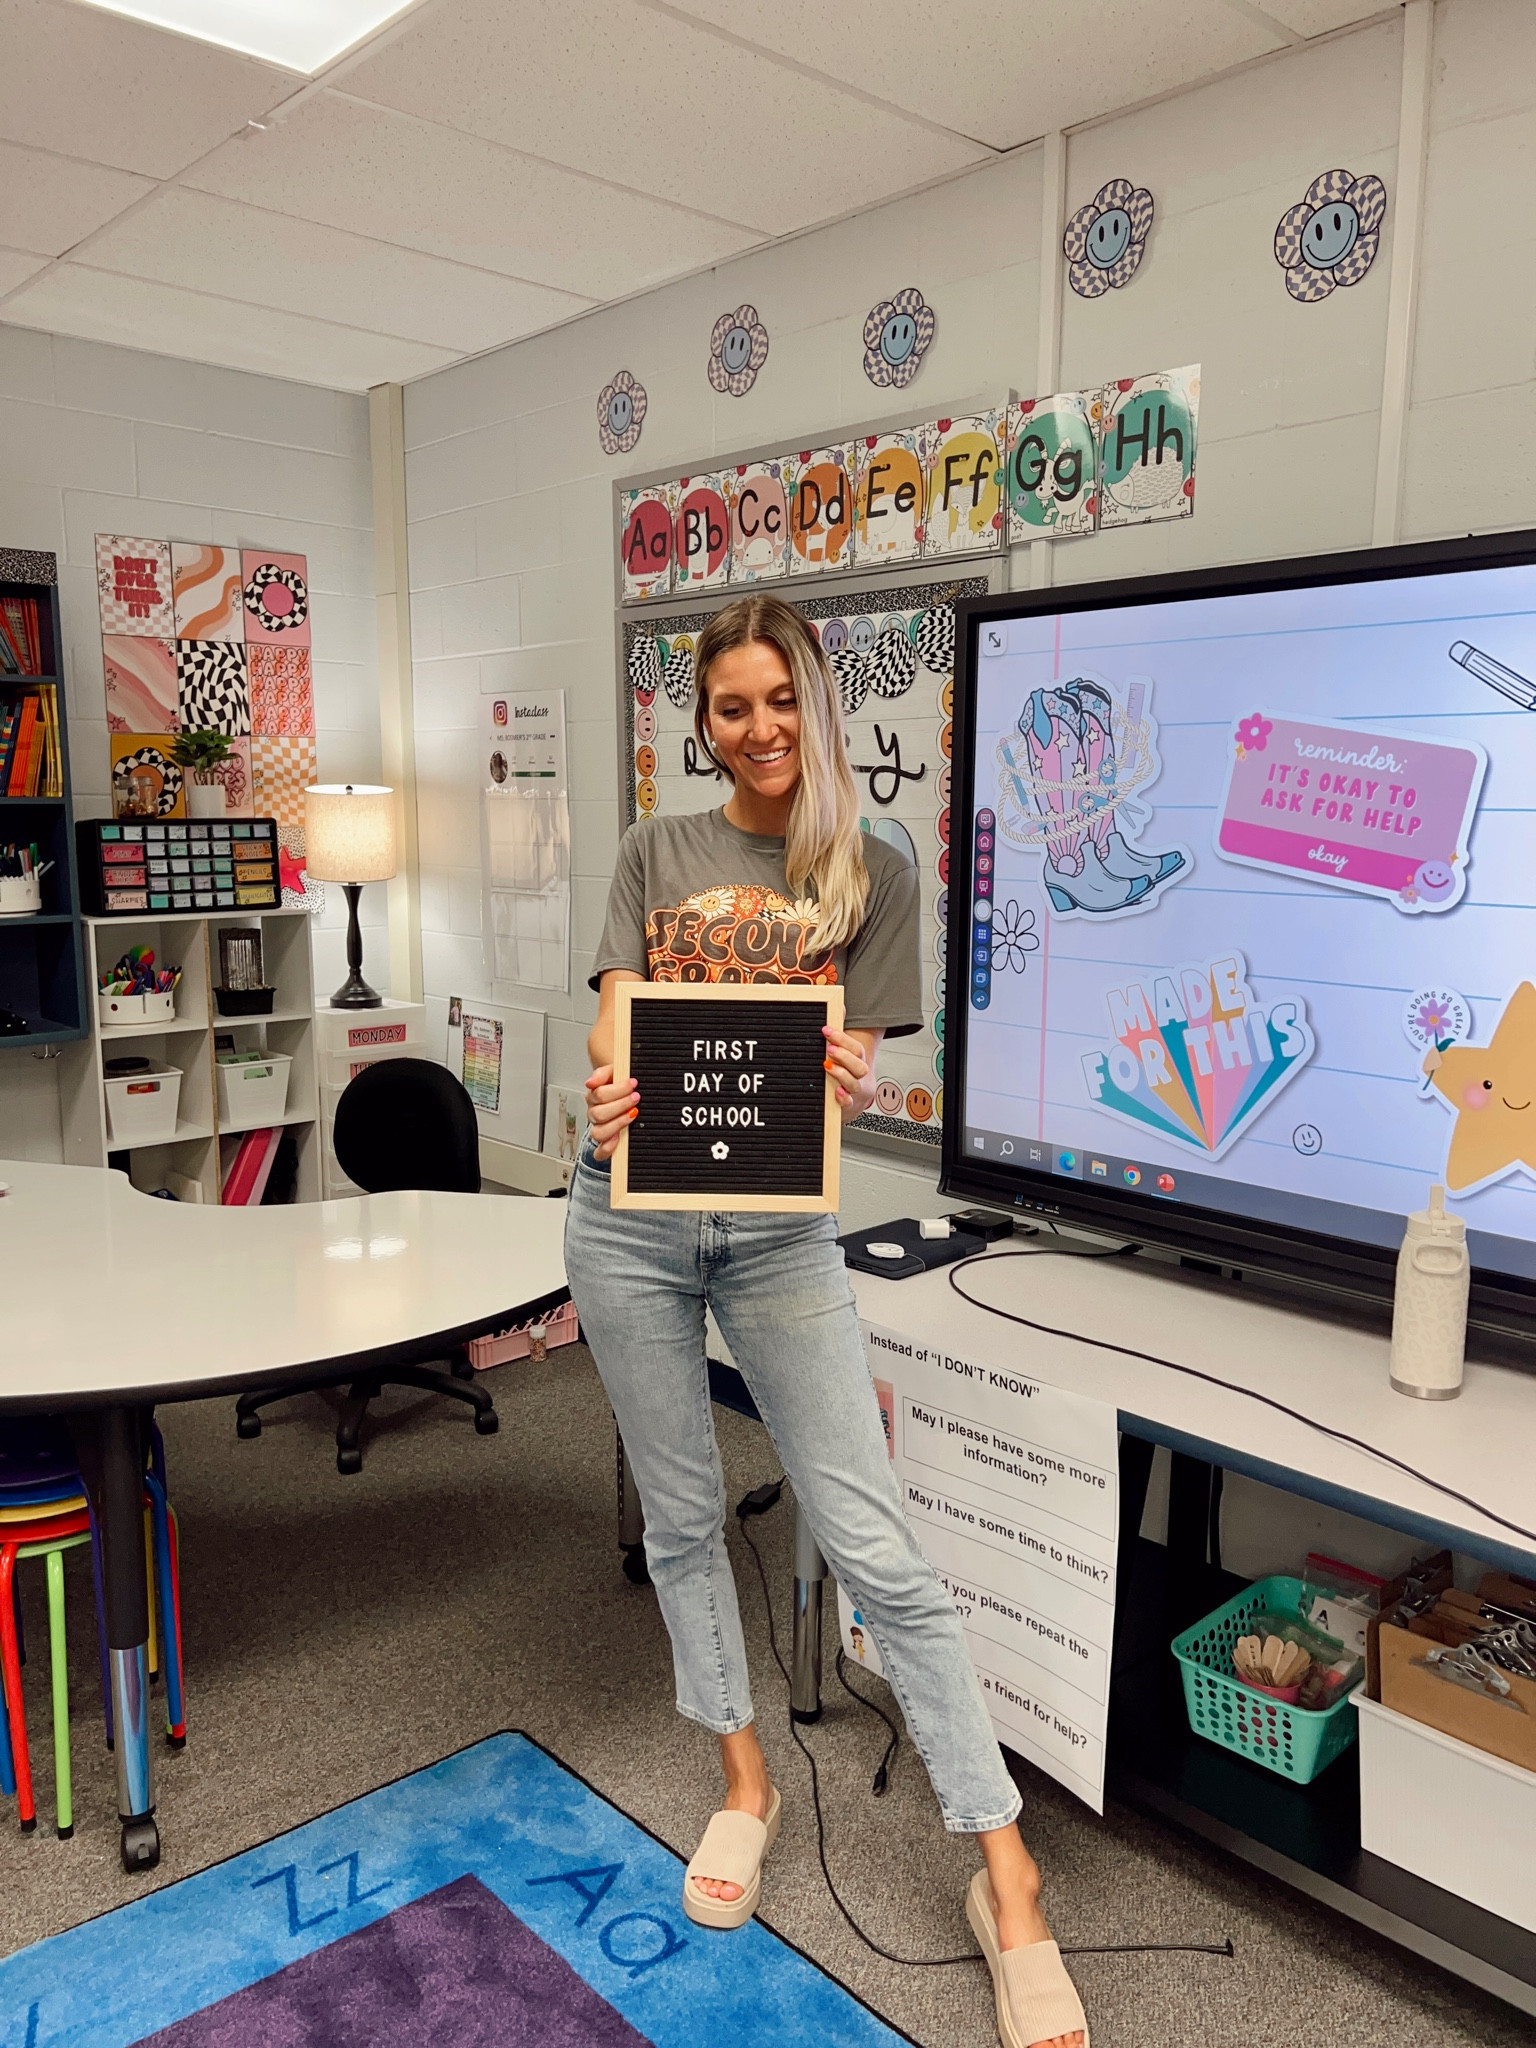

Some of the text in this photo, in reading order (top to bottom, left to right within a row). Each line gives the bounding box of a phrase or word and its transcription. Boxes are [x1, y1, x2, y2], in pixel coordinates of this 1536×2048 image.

[1115, 404, 1183, 471] Hh
[866, 463, 916, 519] Ee
[942, 449, 993, 511] Ff
[1015, 434, 1082, 502] Gg
[738, 489, 781, 537] Cc
[799, 472, 844, 531] Dd
[1101, 517, 1128, 525] hedgehog
[628, 518, 667, 563] Aa
[683, 506, 723, 557] Bb
[250, 646, 308, 663] HAPPY
[250, 659, 309, 677] HAPPY
[251, 674, 310, 692] HAPPY
[252, 689, 310, 707] HAPPY
[253, 704, 311, 722] HAPPY
[253, 719, 312, 736] HAPPY
[1294, 737, 1408, 774] reminder:
[1268, 763, 1417, 809] IT'S OKAY TO
[1261, 788, 1422, 837] ASK FOR HELP
[1308, 844, 1348, 873] okay
[111, 896, 144, 904] SHARPIES
[1106, 958, 1246, 1038] MADE
[1407, 991, 1464, 1045] YOU'RE DOING SO GREAT
[352, 1028, 402, 1044] MONDAY
[693, 1040, 758, 1060] FIRST
[1080, 1002, 1306, 1100] FOR THIS
[684, 1072, 765, 1094] DAY OF
[680, 1106, 765, 1127] SCHOOL
[870, 1332, 912, 1357] Instead
[916, 1349, 928, 1362] of
[945, 1357, 986, 1381] DON’T
[912, 1406, 936, 1428] May
[940, 1416, 944, 1429] I
[947, 1421, 989, 1444] please
[993, 1435, 1024, 1458] have
[1027, 1450, 1065, 1473] some
[1069, 1466, 1106, 1489] more
[963, 1444, 1048, 1486] information?
[909, 1487, 1109, 1584] May I have some time to think?
[952, 1584, 976, 1602] you
[980, 1595, 1022, 1622] please
[1026, 1617, 1066, 1646] repeat
[1069, 1638, 1089, 1659] the
[983, 1678, 1087, 1749] a friend for help?
[525, 1862, 689, 1979] Aa
